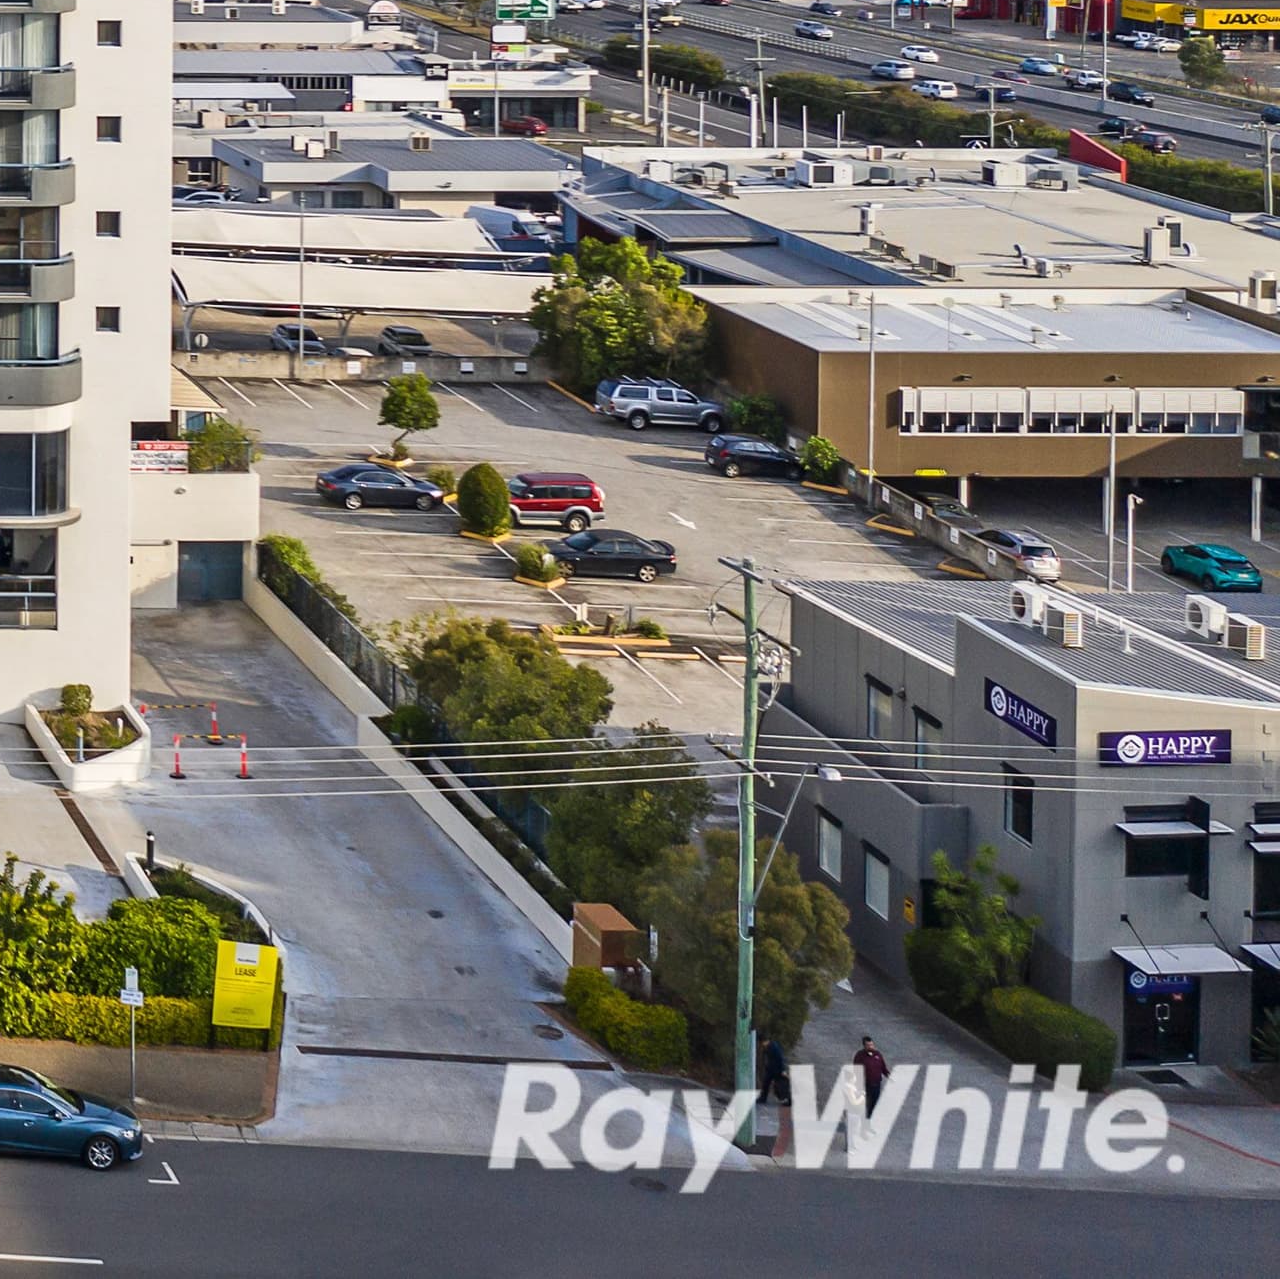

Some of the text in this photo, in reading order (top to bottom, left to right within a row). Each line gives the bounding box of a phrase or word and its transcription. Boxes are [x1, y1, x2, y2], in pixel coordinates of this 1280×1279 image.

[1219, 13, 1259, 25] JAX
[1008, 696, 1049, 736] HAPPY
[1147, 736, 1216, 755] HAPPY
[234, 967, 257, 977] LEASE
